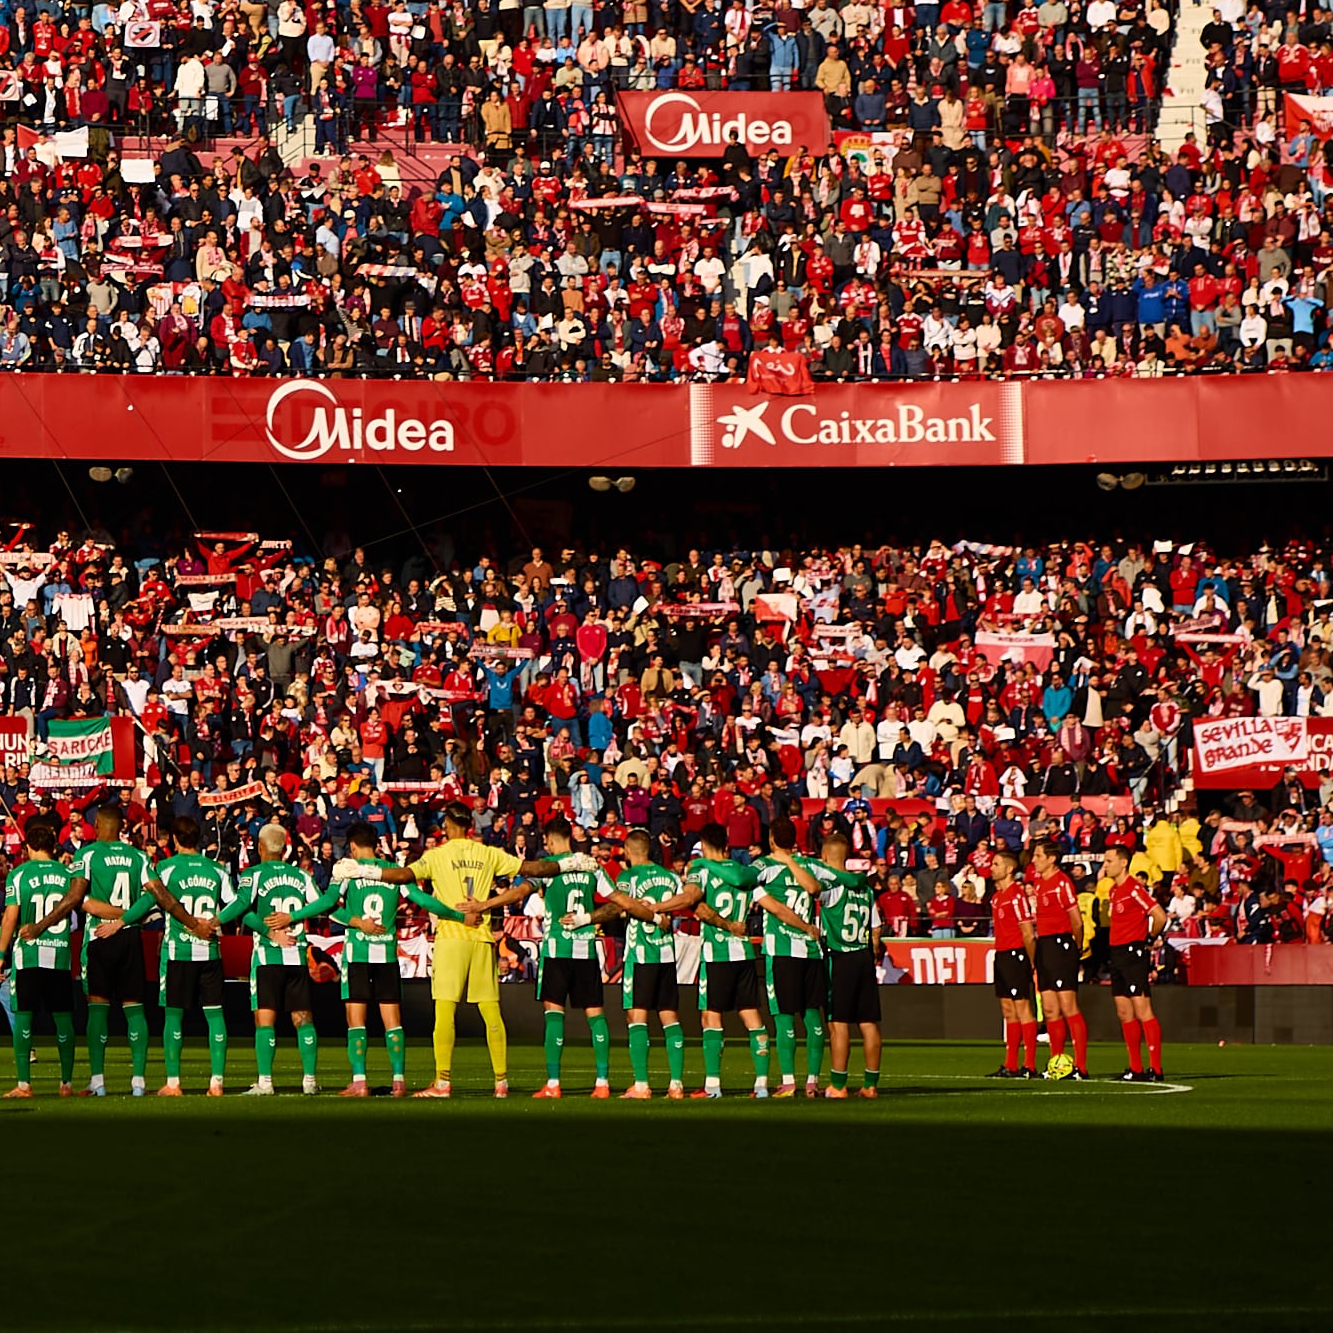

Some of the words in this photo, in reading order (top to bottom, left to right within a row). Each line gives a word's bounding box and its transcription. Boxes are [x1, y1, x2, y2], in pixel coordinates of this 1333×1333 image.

[666, 112, 792, 144] Midea
[294, 407, 455, 452] Midea
[781, 403, 997, 444] CaixaBank
[104, 856, 133, 868] NATAN
[43, 875, 67, 888] ABDE
[109, 872, 131, 910] 4
[178, 875, 217, 891] V.GÓMEZ
[463, 876, 475, 898] 1
[179, 895, 216, 921] 16
[361, 894, 384, 926] 8
[715, 891, 748, 923] 21
[841, 903, 870, 944] 52
[36, 939, 69, 948] trainline
